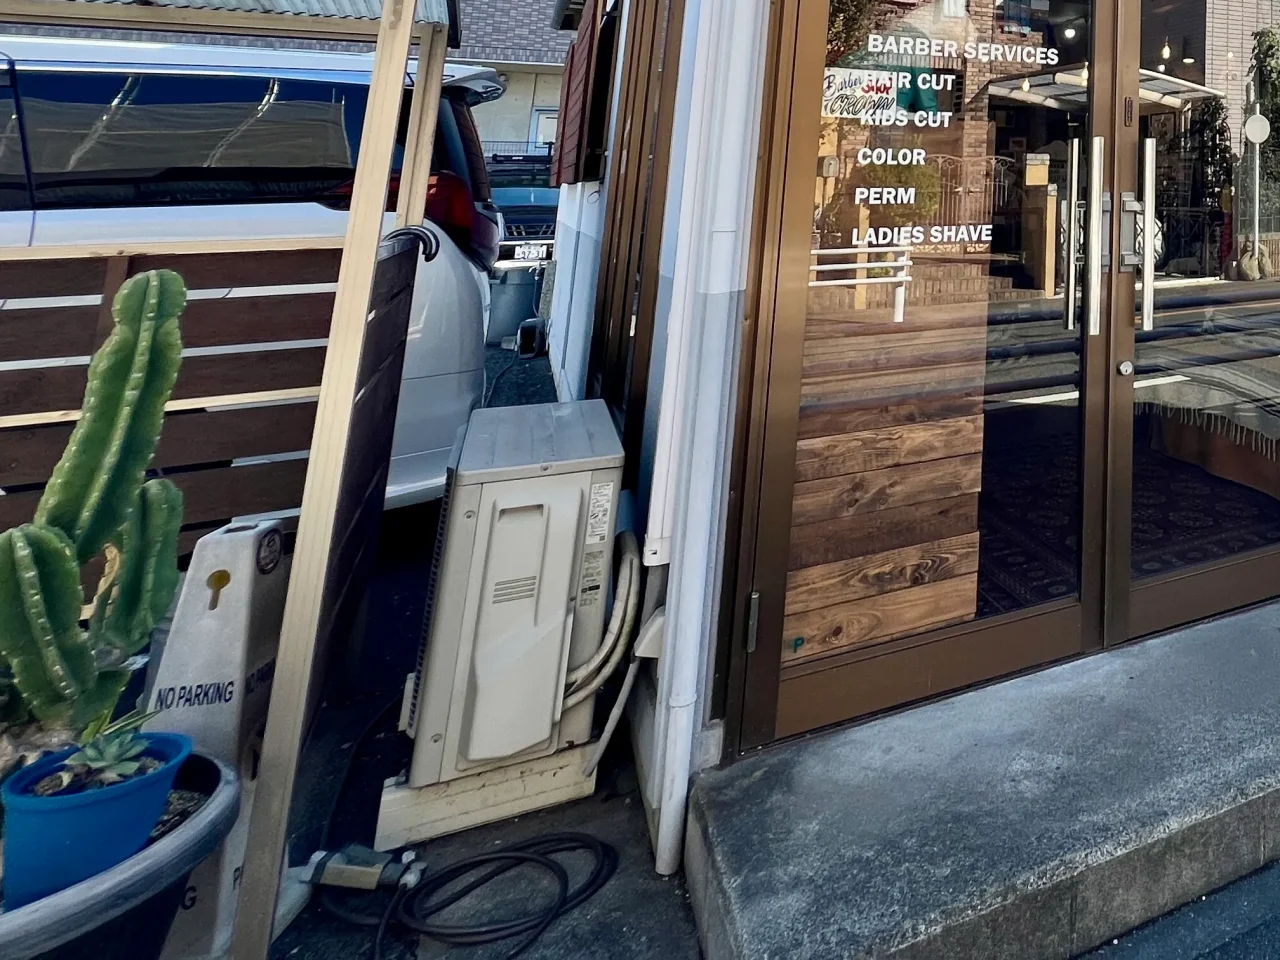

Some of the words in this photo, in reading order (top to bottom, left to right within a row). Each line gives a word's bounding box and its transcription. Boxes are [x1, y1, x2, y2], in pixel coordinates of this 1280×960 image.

[867, 33, 959, 58] BARBER
[963, 43, 1059, 66] SERVICES
[864, 71, 911, 89] HAIR
[917, 73, 956, 91] CUT
[829, 93, 896, 116] CROWN
[859, 110, 909, 126] KIDS
[914, 111, 953, 128] CUT
[857, 147, 926, 166] COLOR
[854, 187, 916, 206] PERM
[851, 226, 925, 246] LADIES
[929, 223, 994, 244] SHAVE
[155, 687, 176, 711] NO
[176, 680, 235, 708] PARKING
